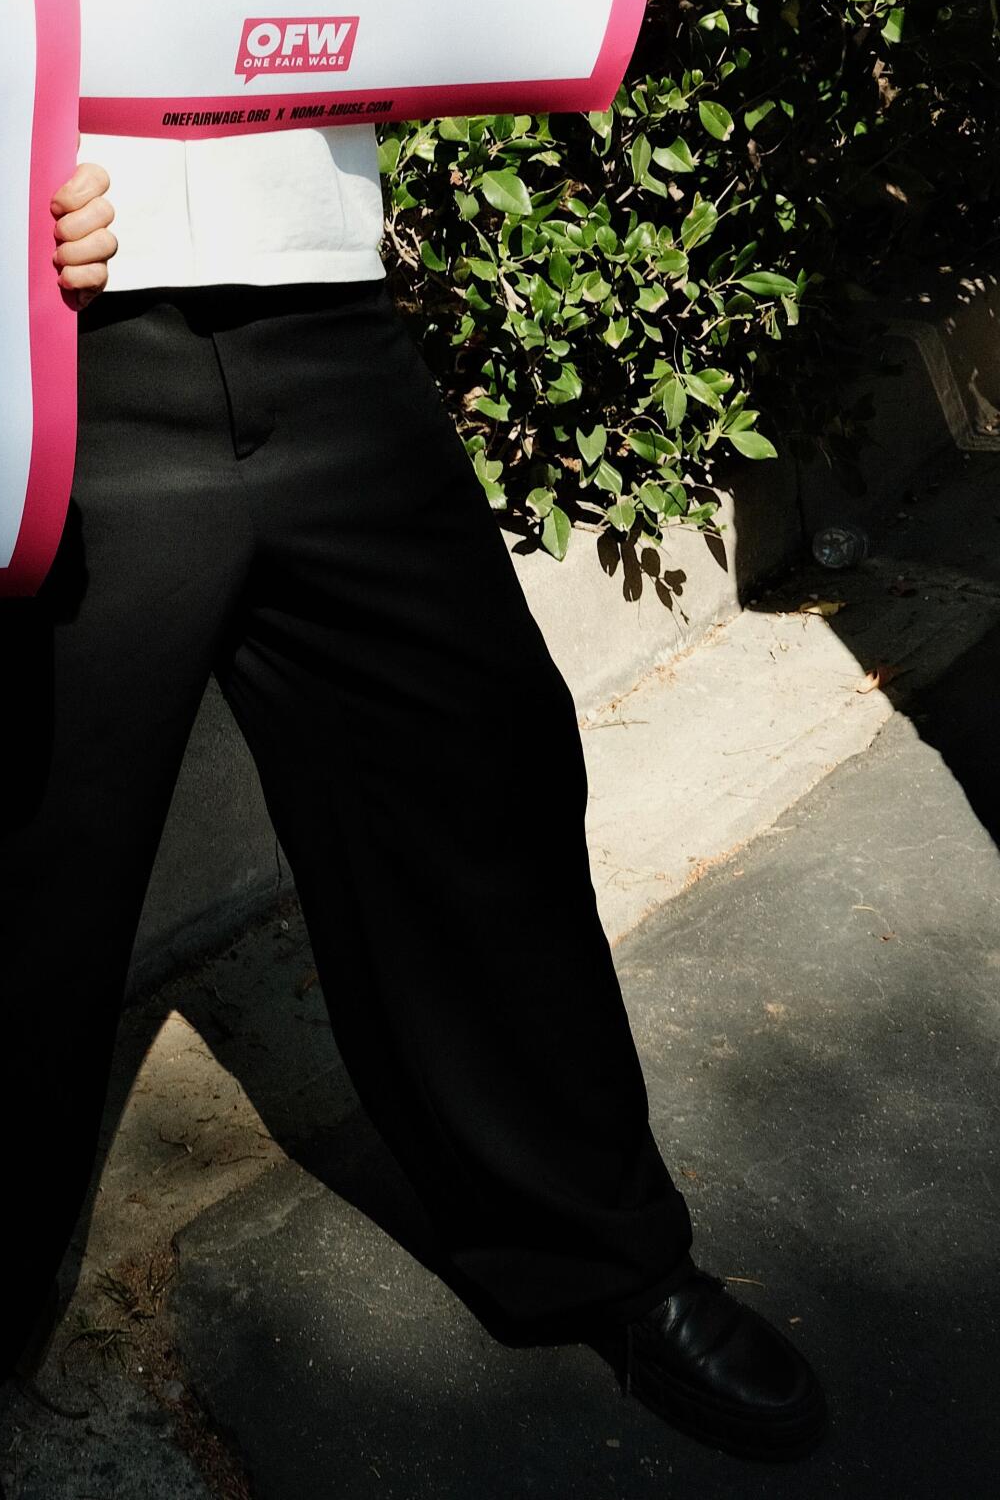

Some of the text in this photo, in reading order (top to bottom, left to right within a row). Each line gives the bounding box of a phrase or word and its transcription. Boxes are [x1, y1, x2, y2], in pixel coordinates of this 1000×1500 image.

[246, 22, 352, 58] OFW
[243, 56, 345, 68] ONE FAIR WAGE
[162, 109, 270, 126] ONEFAIRWAGE.ORG
[290, 101, 394, 120] NOMA-ABUSE.COM
